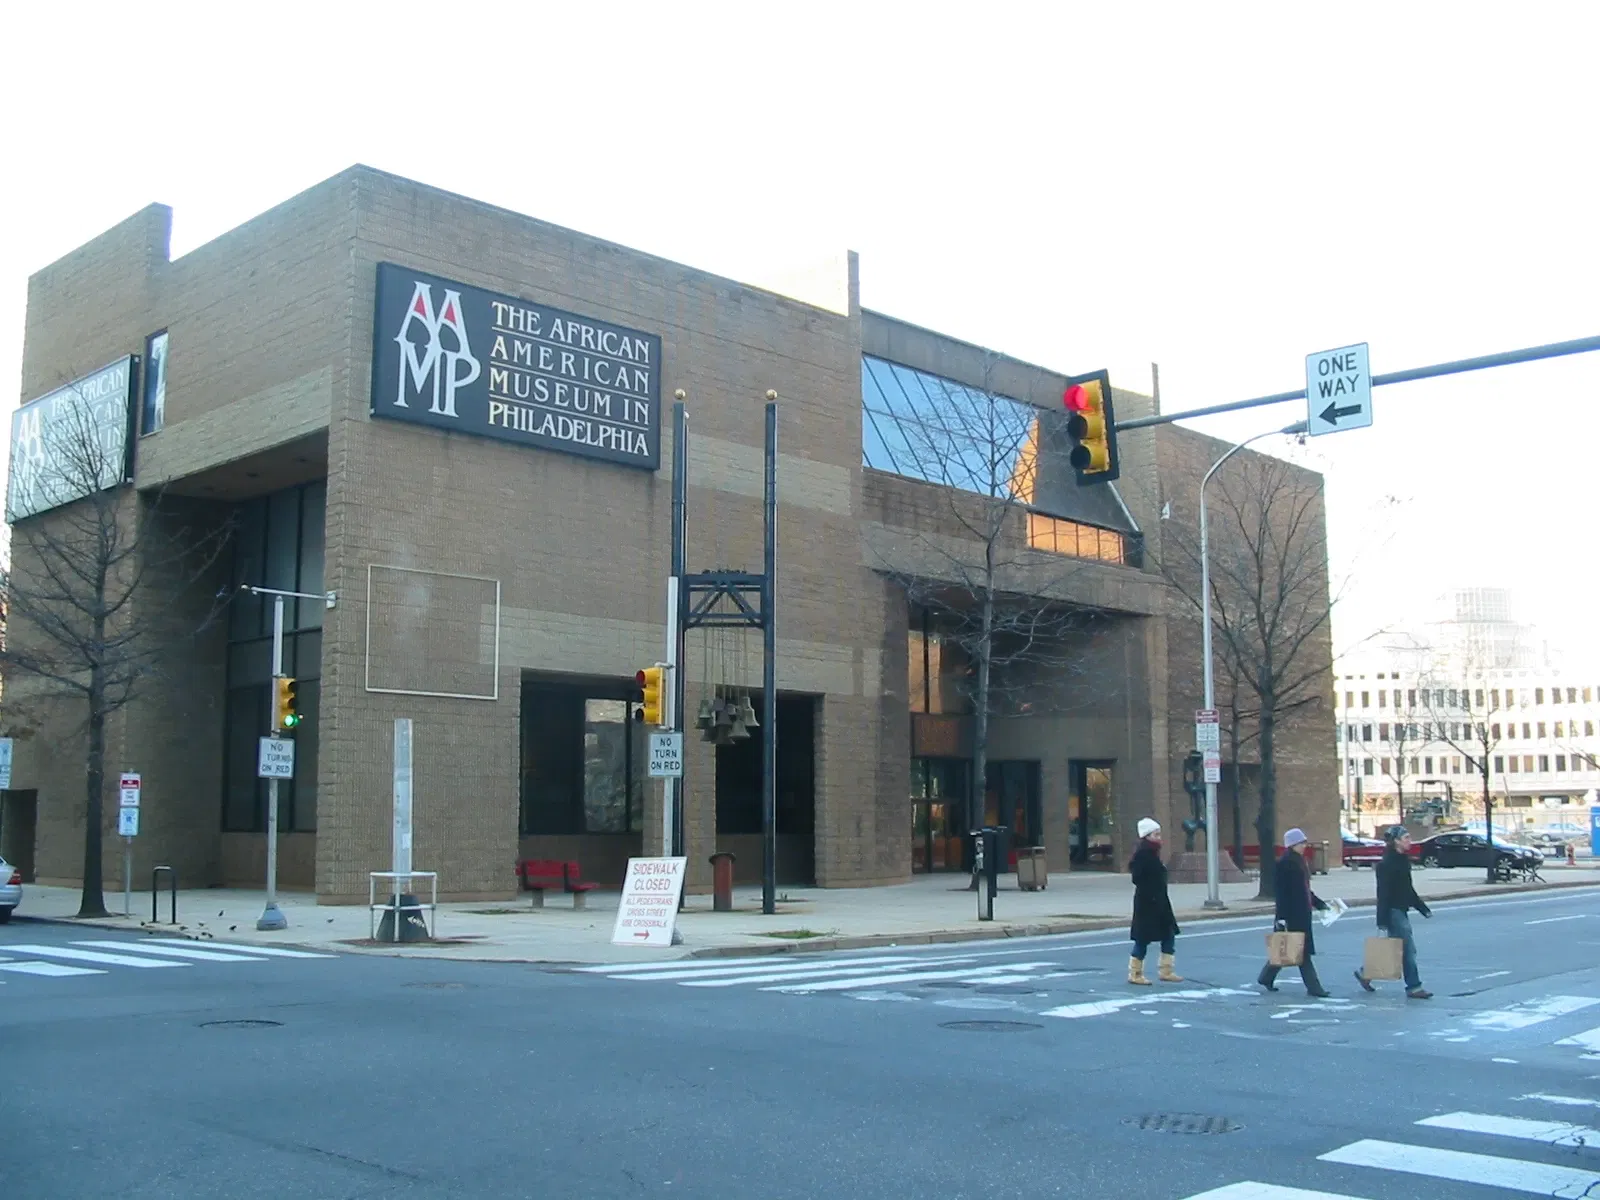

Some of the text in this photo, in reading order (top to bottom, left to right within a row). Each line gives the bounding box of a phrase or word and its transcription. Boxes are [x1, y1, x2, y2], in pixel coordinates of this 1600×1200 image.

[491, 301, 650, 363] THE AFRICAN
[490, 335, 650, 394] AMERICAN
[1318, 352, 1358, 377] ONE
[1318, 373, 1361, 399] WAY
[489, 367, 650, 425] MUSEUM IN
[488, 400, 650, 456] PHILADELPHIA
[270, 743, 284, 752] NO
[660, 737, 672, 747] NO
[655, 749, 677, 759] TURN
[650, 761, 681, 770] ON RED
[633, 862, 679, 876] SIDEWALK
[634, 878, 672, 891] CLOSED
